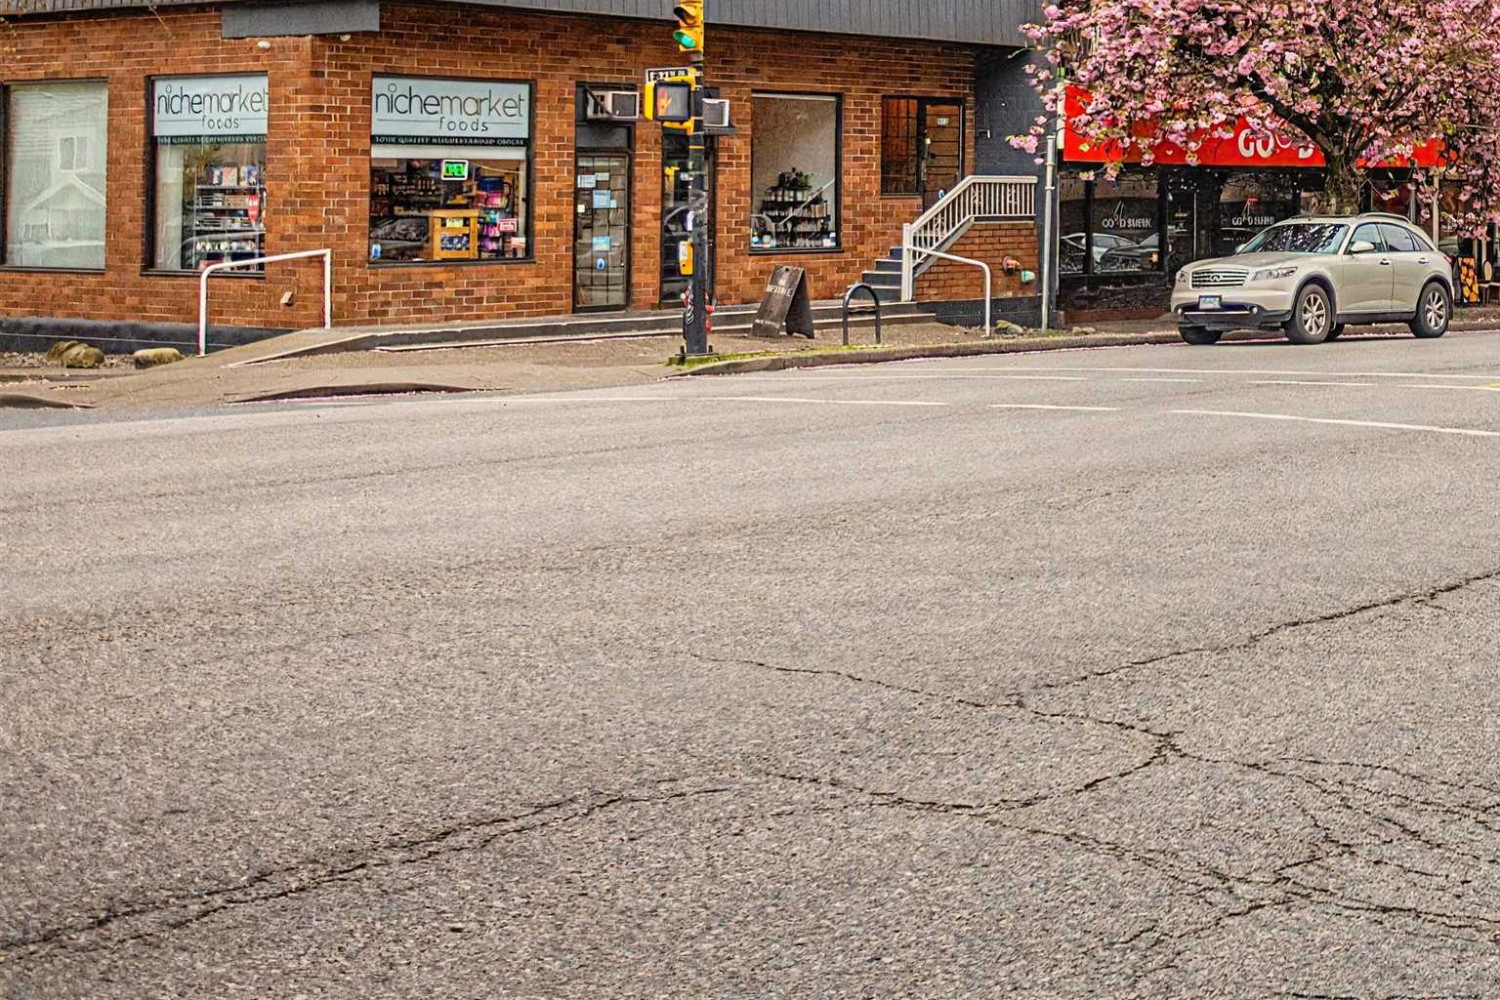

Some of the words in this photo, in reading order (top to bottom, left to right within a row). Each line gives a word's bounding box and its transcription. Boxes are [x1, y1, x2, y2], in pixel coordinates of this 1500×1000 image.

[157, 84, 268, 115] nichemarket
[375, 83, 525, 117] nichemarket
[202, 115, 240, 129] foods
[439, 117, 489, 132] foods
